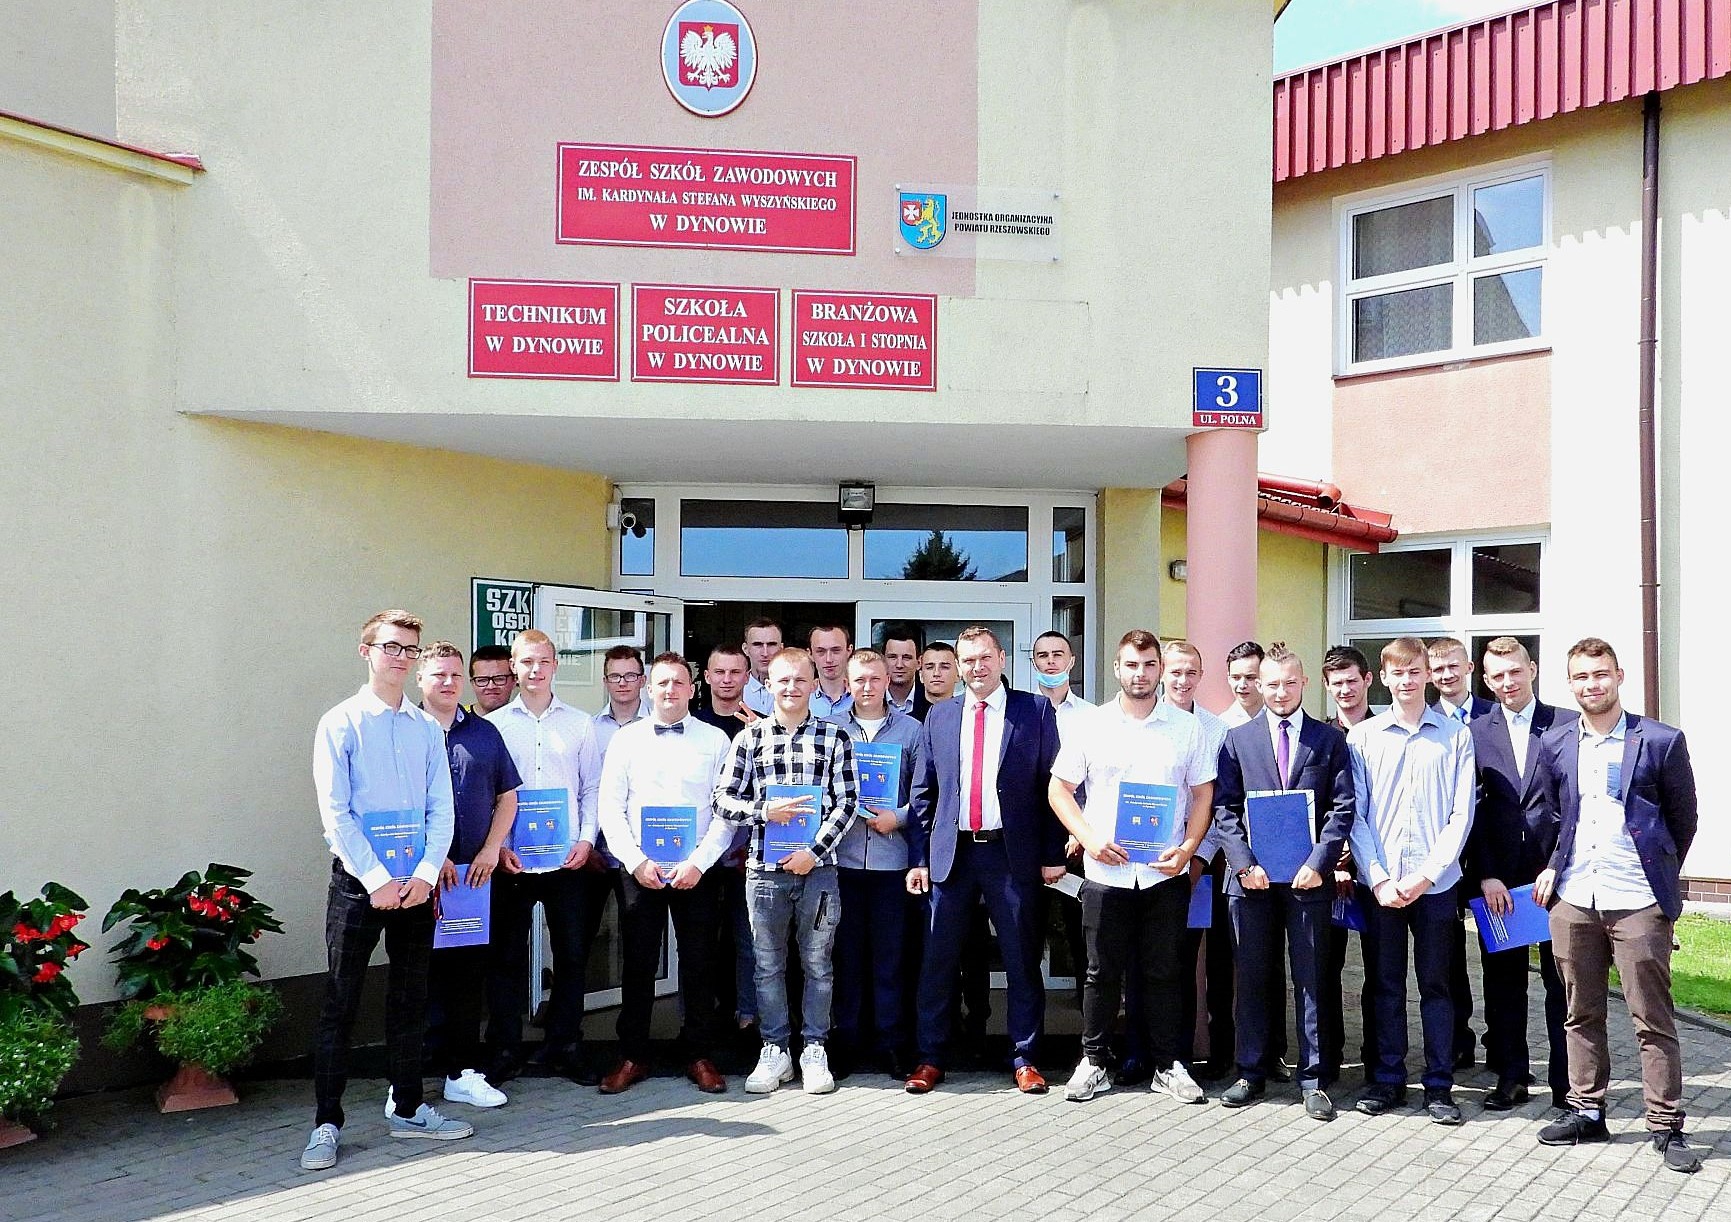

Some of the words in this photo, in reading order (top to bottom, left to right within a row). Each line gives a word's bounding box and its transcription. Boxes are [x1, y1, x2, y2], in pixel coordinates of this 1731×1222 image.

[578, 157, 643, 179] ZESPÓŁ
[650, 160, 706, 182] SZKÓŁ
[713, 166, 838, 188] ZAWODOWYCH
[577, 187, 597, 201] IM.
[602, 188, 678, 204] KARDYNAŁA
[682, 192, 736, 207] STEFANA
[741, 194, 837, 211] WYSZYŃSKIEGO
[649, 213, 668, 231] W
[676, 215, 767, 235] DYNOWIE
[951, 211, 994, 222] JEDNOSTKA
[994, 213, 1054, 225] ORGANIZACYJNA
[954, 222, 989, 233] POWIATU
[989, 224, 1050, 236] RZESZOWSKIEGO
[481, 304, 607, 325] TECHNIKUM
[664, 297, 748, 318] SZKOŁA
[811, 301, 919, 324] BRANŻOWA
[485, 335, 504, 353] W
[512, 336, 604, 355] DYNOWIE
[641, 324, 770, 345] POLICEALNA
[802, 330, 856, 348] SZKOŁA
[860, 333, 866, 348] I
[871, 333, 928, 350] STOPNIA
[647, 352, 666, 369] W
[673, 353, 763, 371] DYNOWIE
[806, 357, 825, 374] W
[832, 358, 922, 377] DYNOWIE
[1215, 375, 1239, 408] 3
[1199, 414, 1218, 424] UL.
[1220, 414, 1257, 425] POLNA
